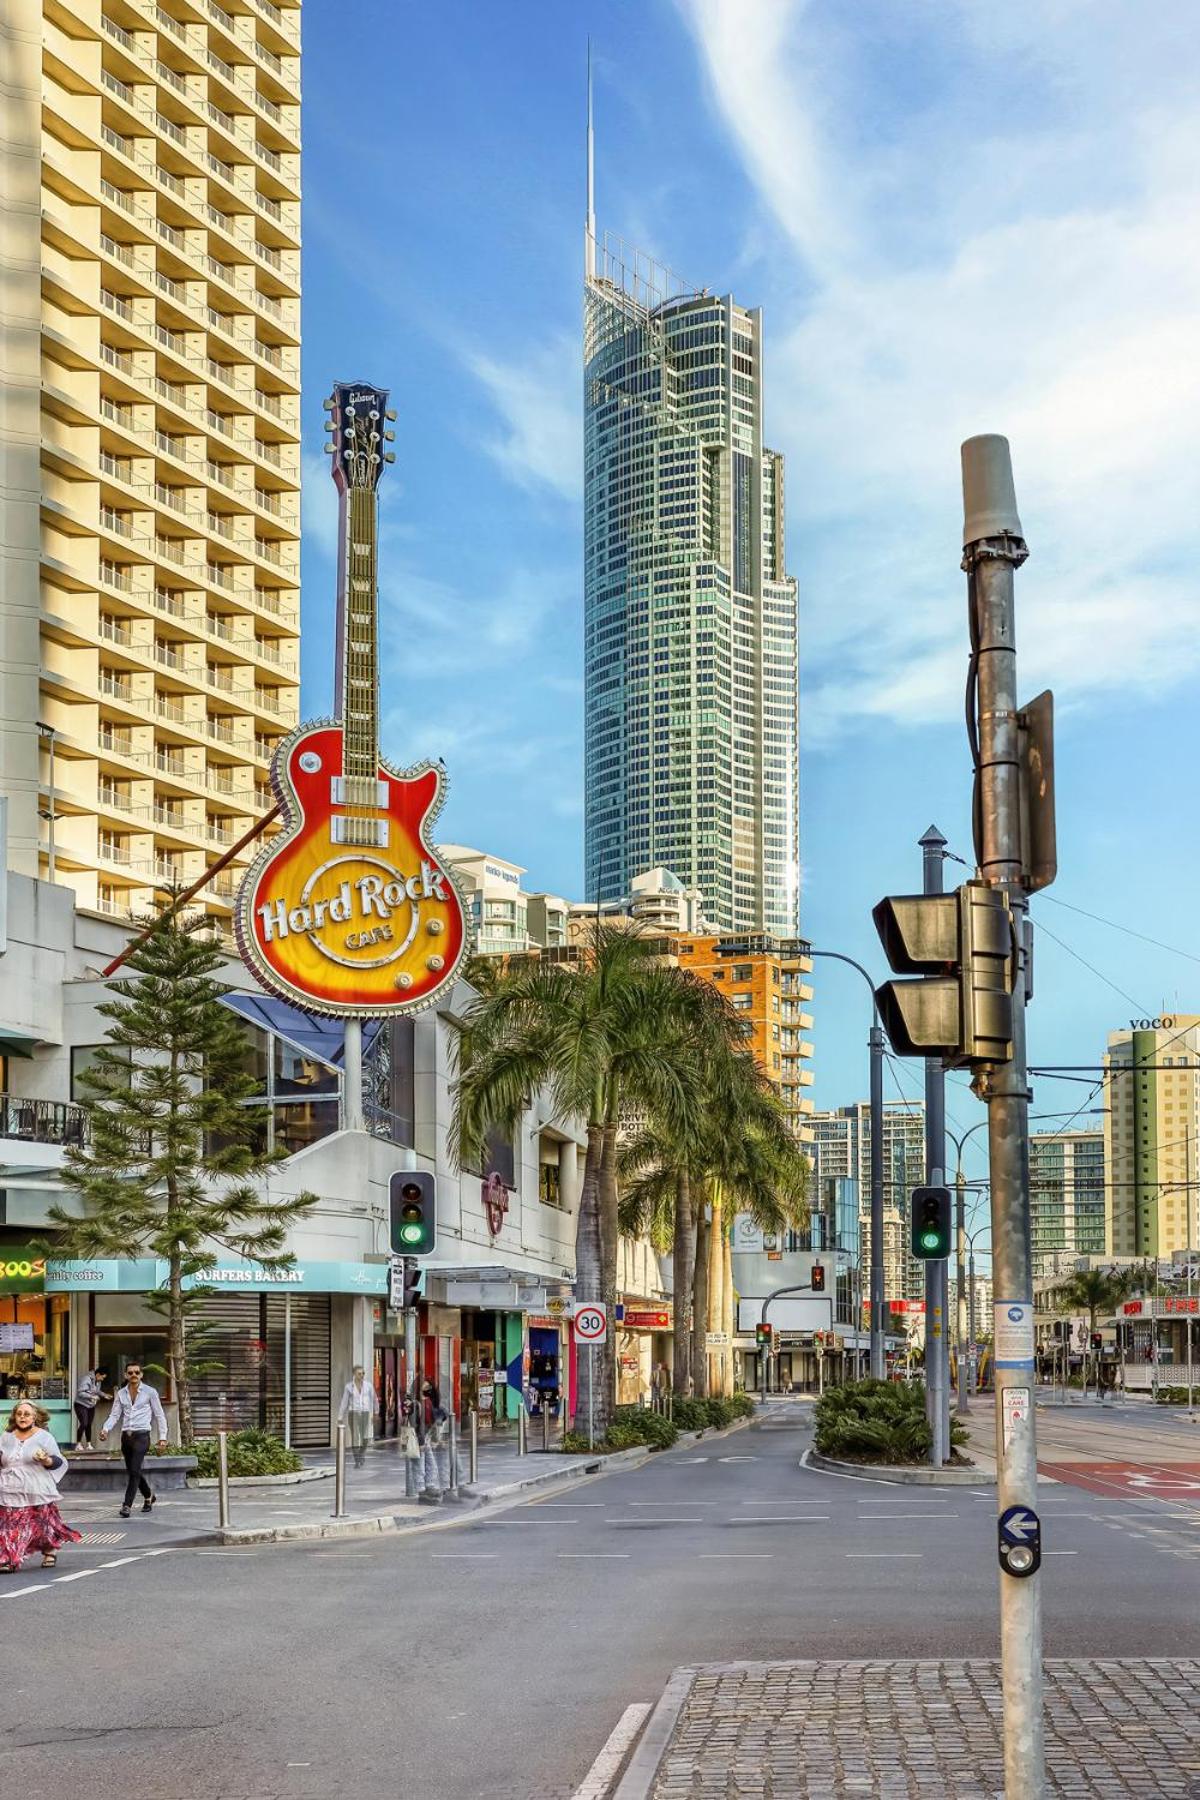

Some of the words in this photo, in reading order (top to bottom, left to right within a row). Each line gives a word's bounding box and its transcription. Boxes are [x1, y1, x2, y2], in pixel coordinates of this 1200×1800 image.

[257, 880, 351, 942] Hard
[355, 858, 451, 919] Rock
[345, 924, 394, 950] CAFE
[73, 1270, 104, 1281] coffee
[195, 1270, 253, 1282] SURFERS
[255, 1270, 305, 1283] BAKERY
[581, 1316, 600, 1330] 30
